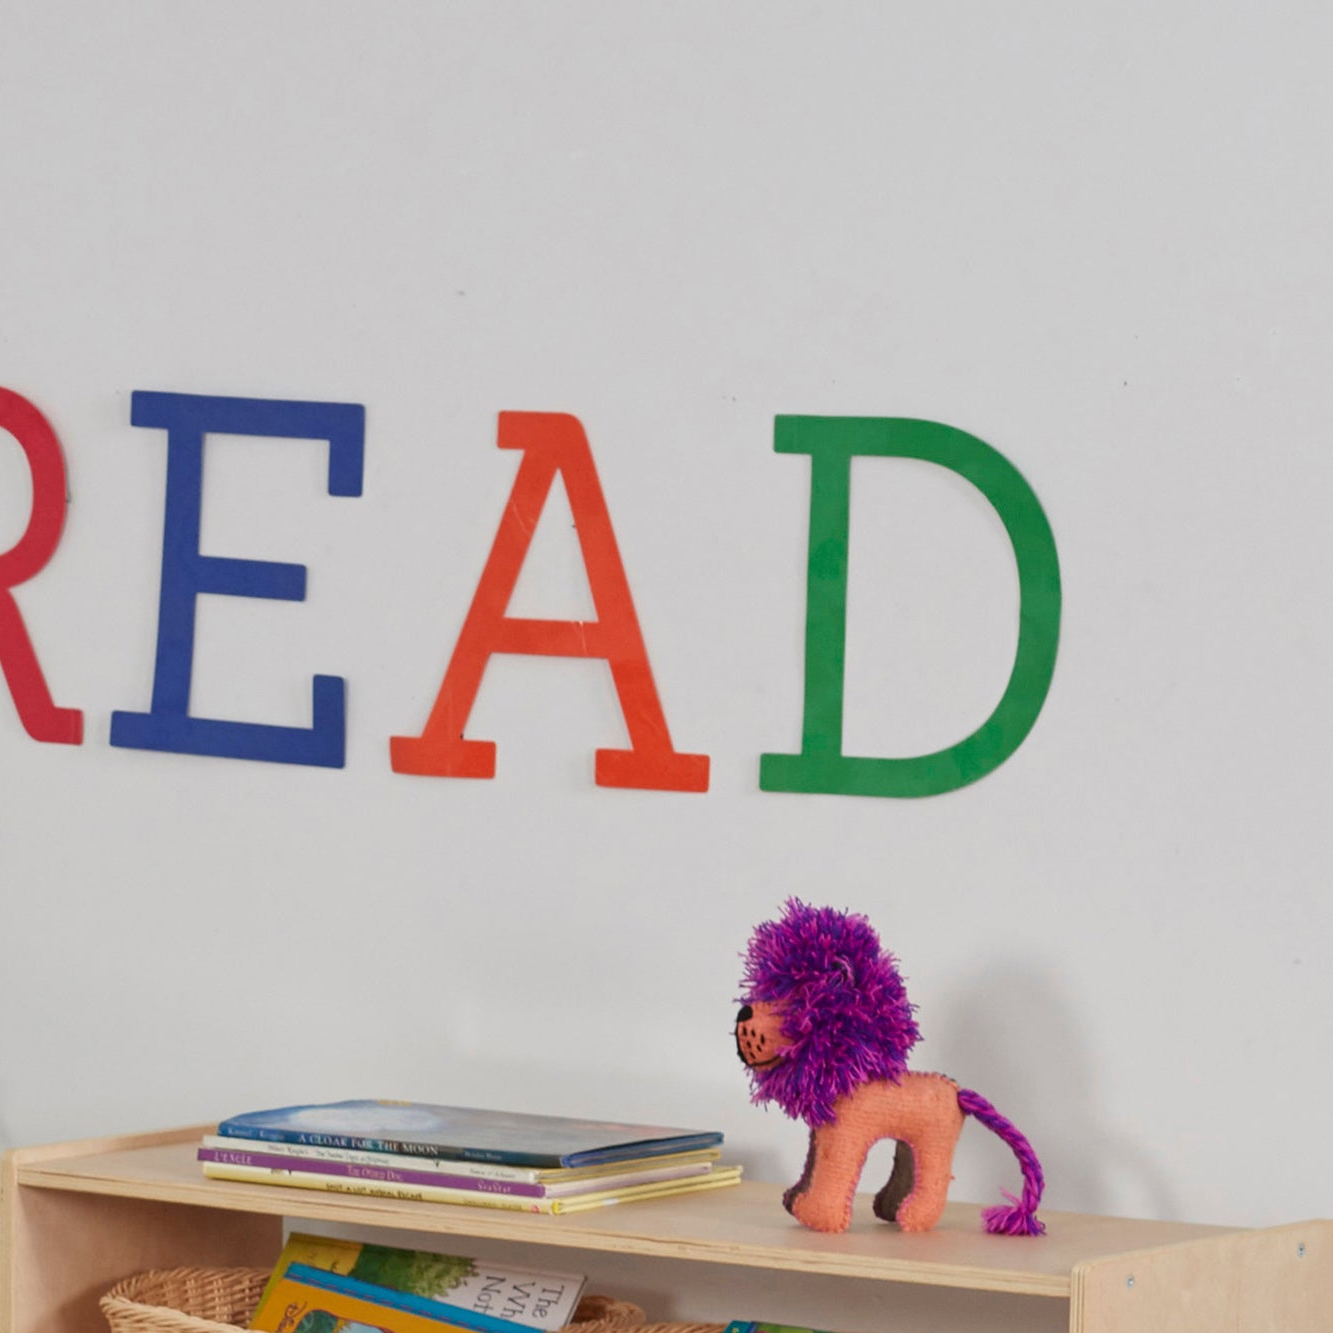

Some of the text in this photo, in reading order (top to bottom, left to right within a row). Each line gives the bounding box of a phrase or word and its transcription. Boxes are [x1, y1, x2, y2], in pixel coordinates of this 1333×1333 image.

[298, 1133, 306, 1143] A
[309, 1134, 347, 1148] CLOAK
[350, 1137, 373, 1150] FOR
[377, 1139, 400, 1152] THE
[402, 1142, 439, 1156] MOON
[500, 1280, 536, 1319] Wh
[532, 1284, 565, 1319] The
